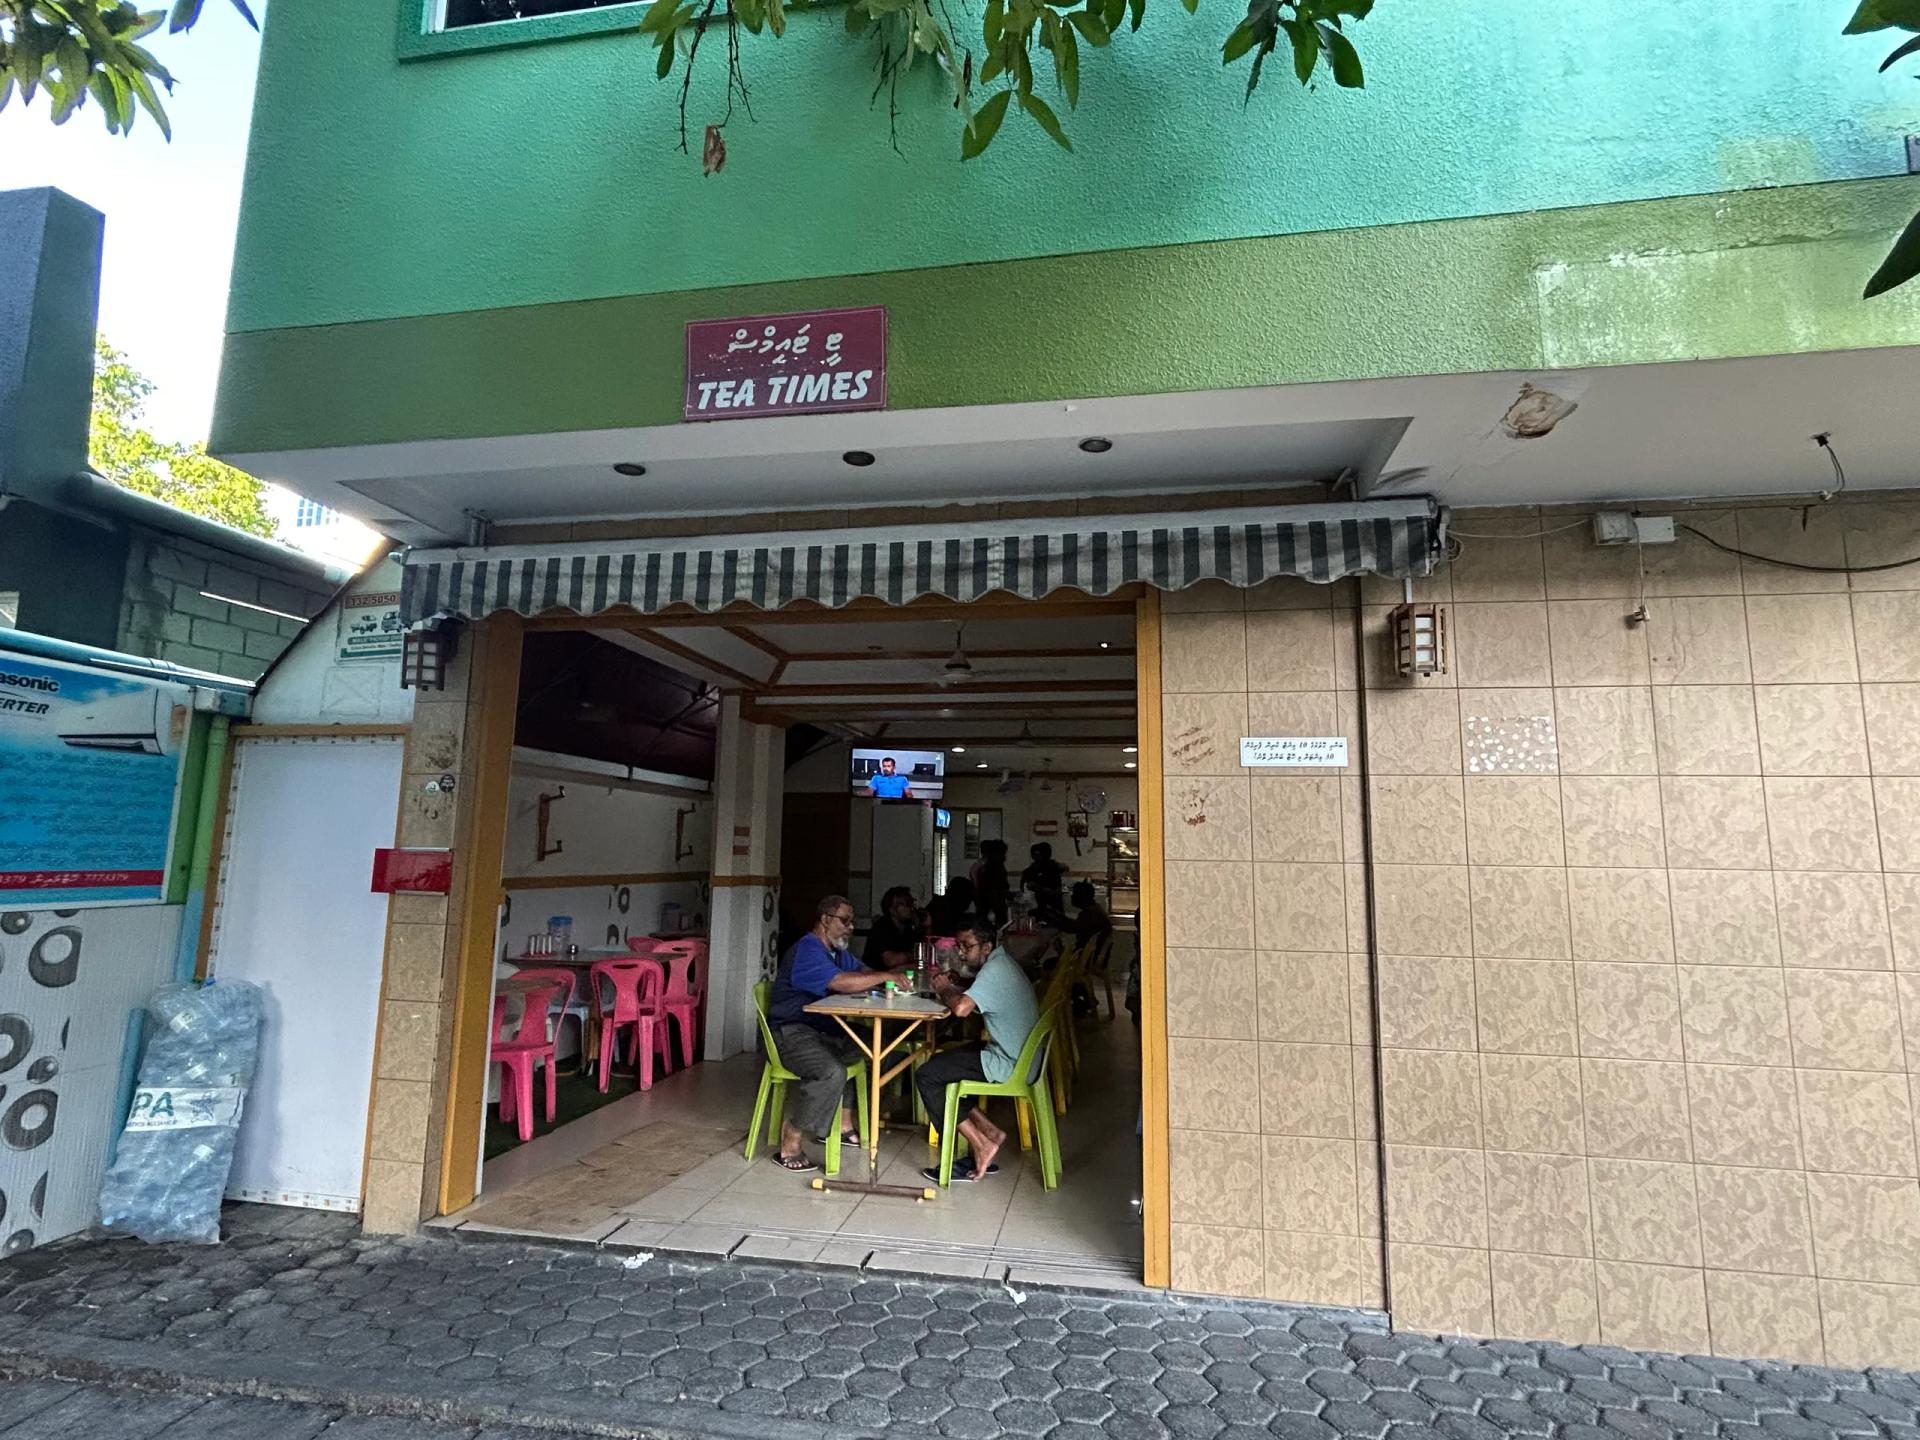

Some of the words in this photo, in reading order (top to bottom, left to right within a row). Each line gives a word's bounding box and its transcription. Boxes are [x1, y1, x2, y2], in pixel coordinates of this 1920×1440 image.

[825, 332, 844, 367] ޓީ
[697, 378, 756, 410] TEA
[768, 369, 873, 406] TIMES
